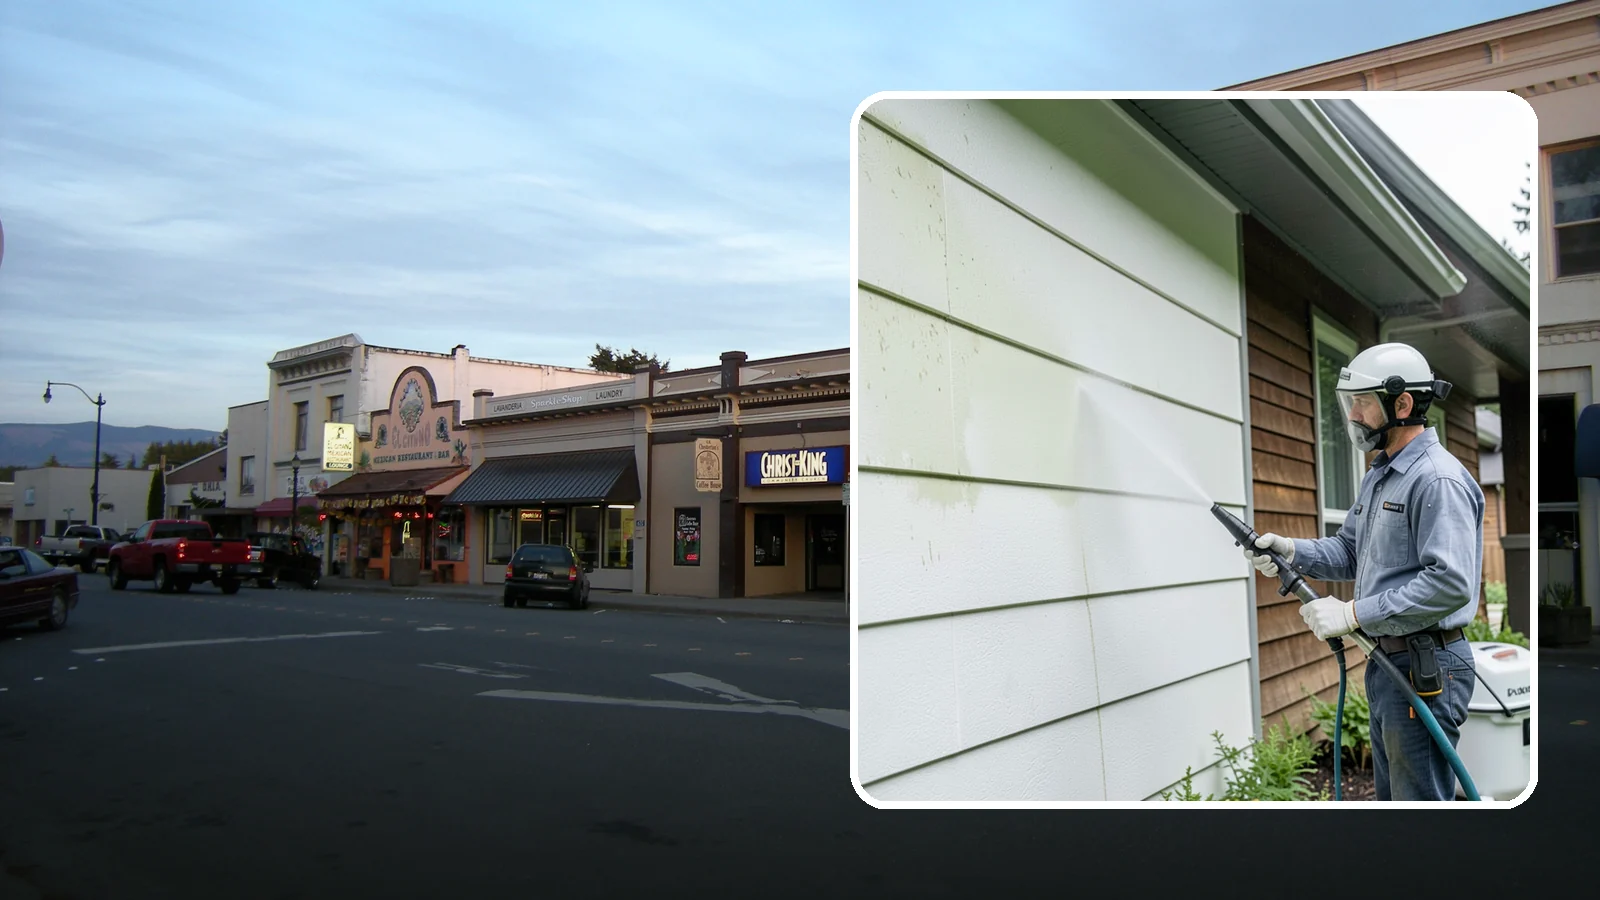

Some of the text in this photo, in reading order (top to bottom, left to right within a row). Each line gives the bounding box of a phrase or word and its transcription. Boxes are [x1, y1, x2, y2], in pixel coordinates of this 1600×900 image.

[561, 394, 582, 404] Shop
[595, 389, 623, 400] LAUNDRY
[493, 402, 522, 412] LAVANDERIA
[373, 450, 450, 464] MEXICAN RESTAURANT BAR
[760, 450, 827, 478] CHRIST KING
